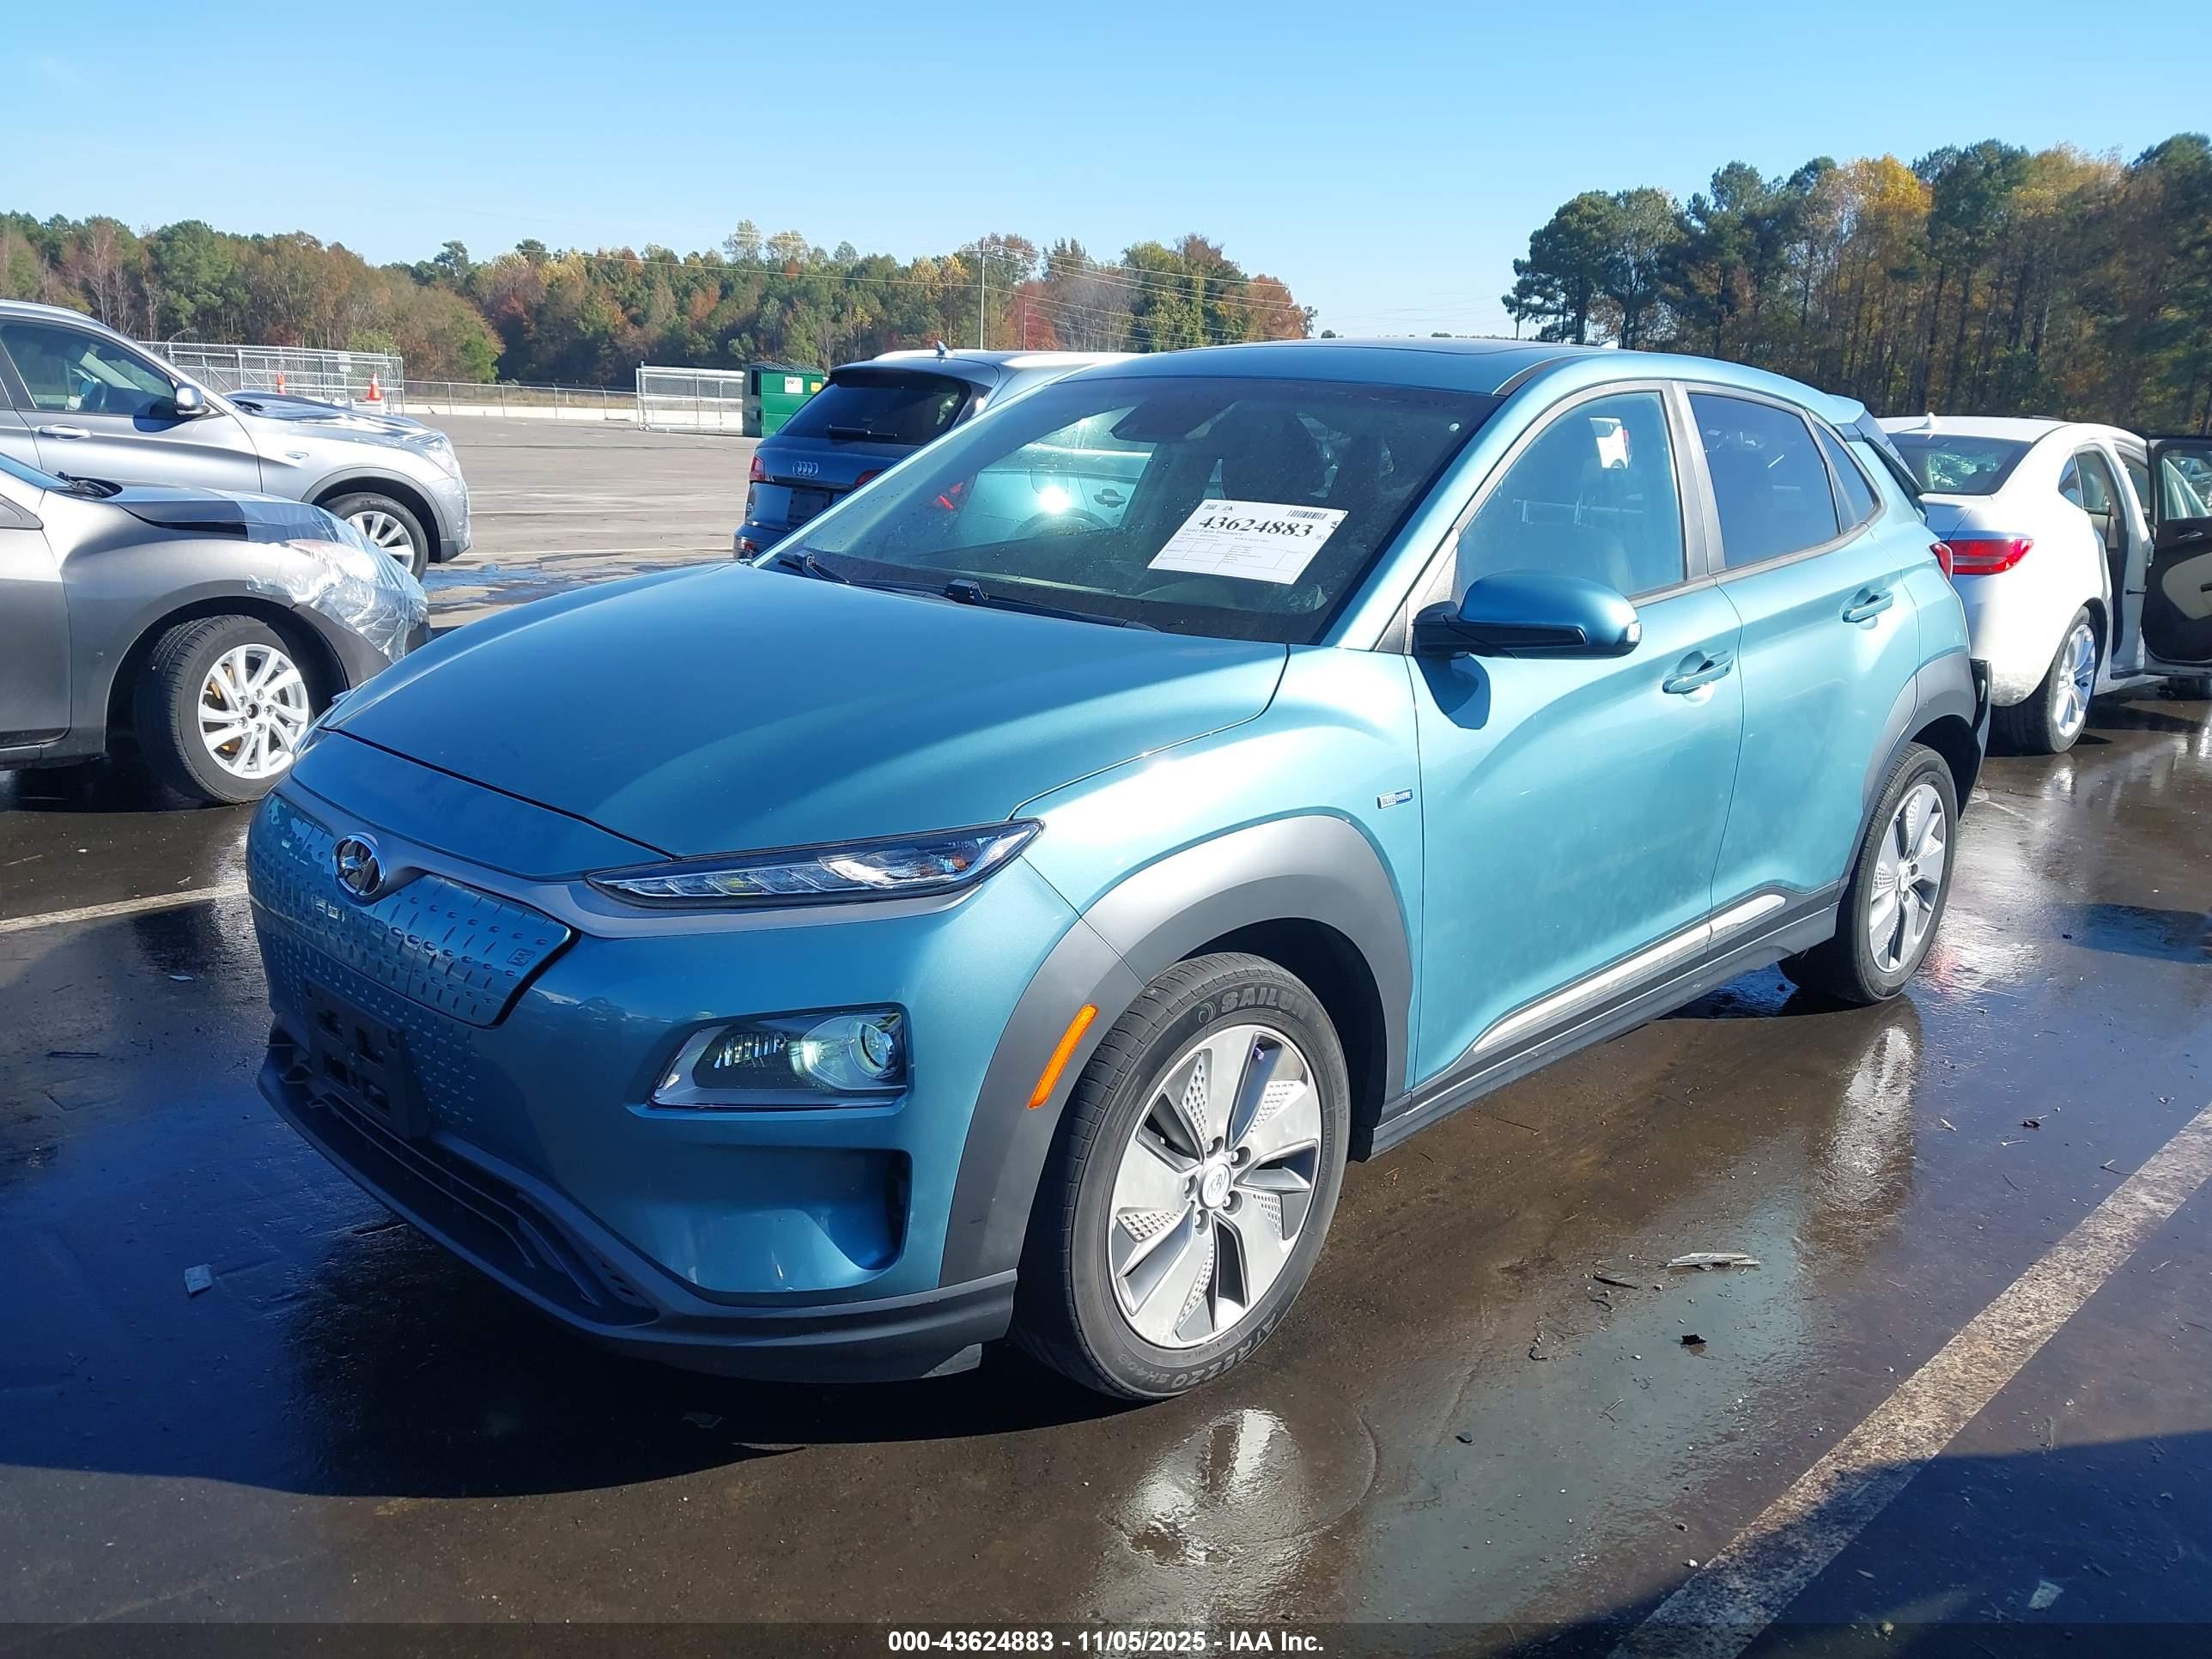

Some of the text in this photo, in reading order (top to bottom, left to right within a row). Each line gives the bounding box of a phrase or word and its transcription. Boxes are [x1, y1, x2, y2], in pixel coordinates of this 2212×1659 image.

[1199, 515, 1314, 538] 43624883
[1221, 987, 1305, 1020] SAILUN
[1170, 1312, 1278, 1389] ATREZZO
